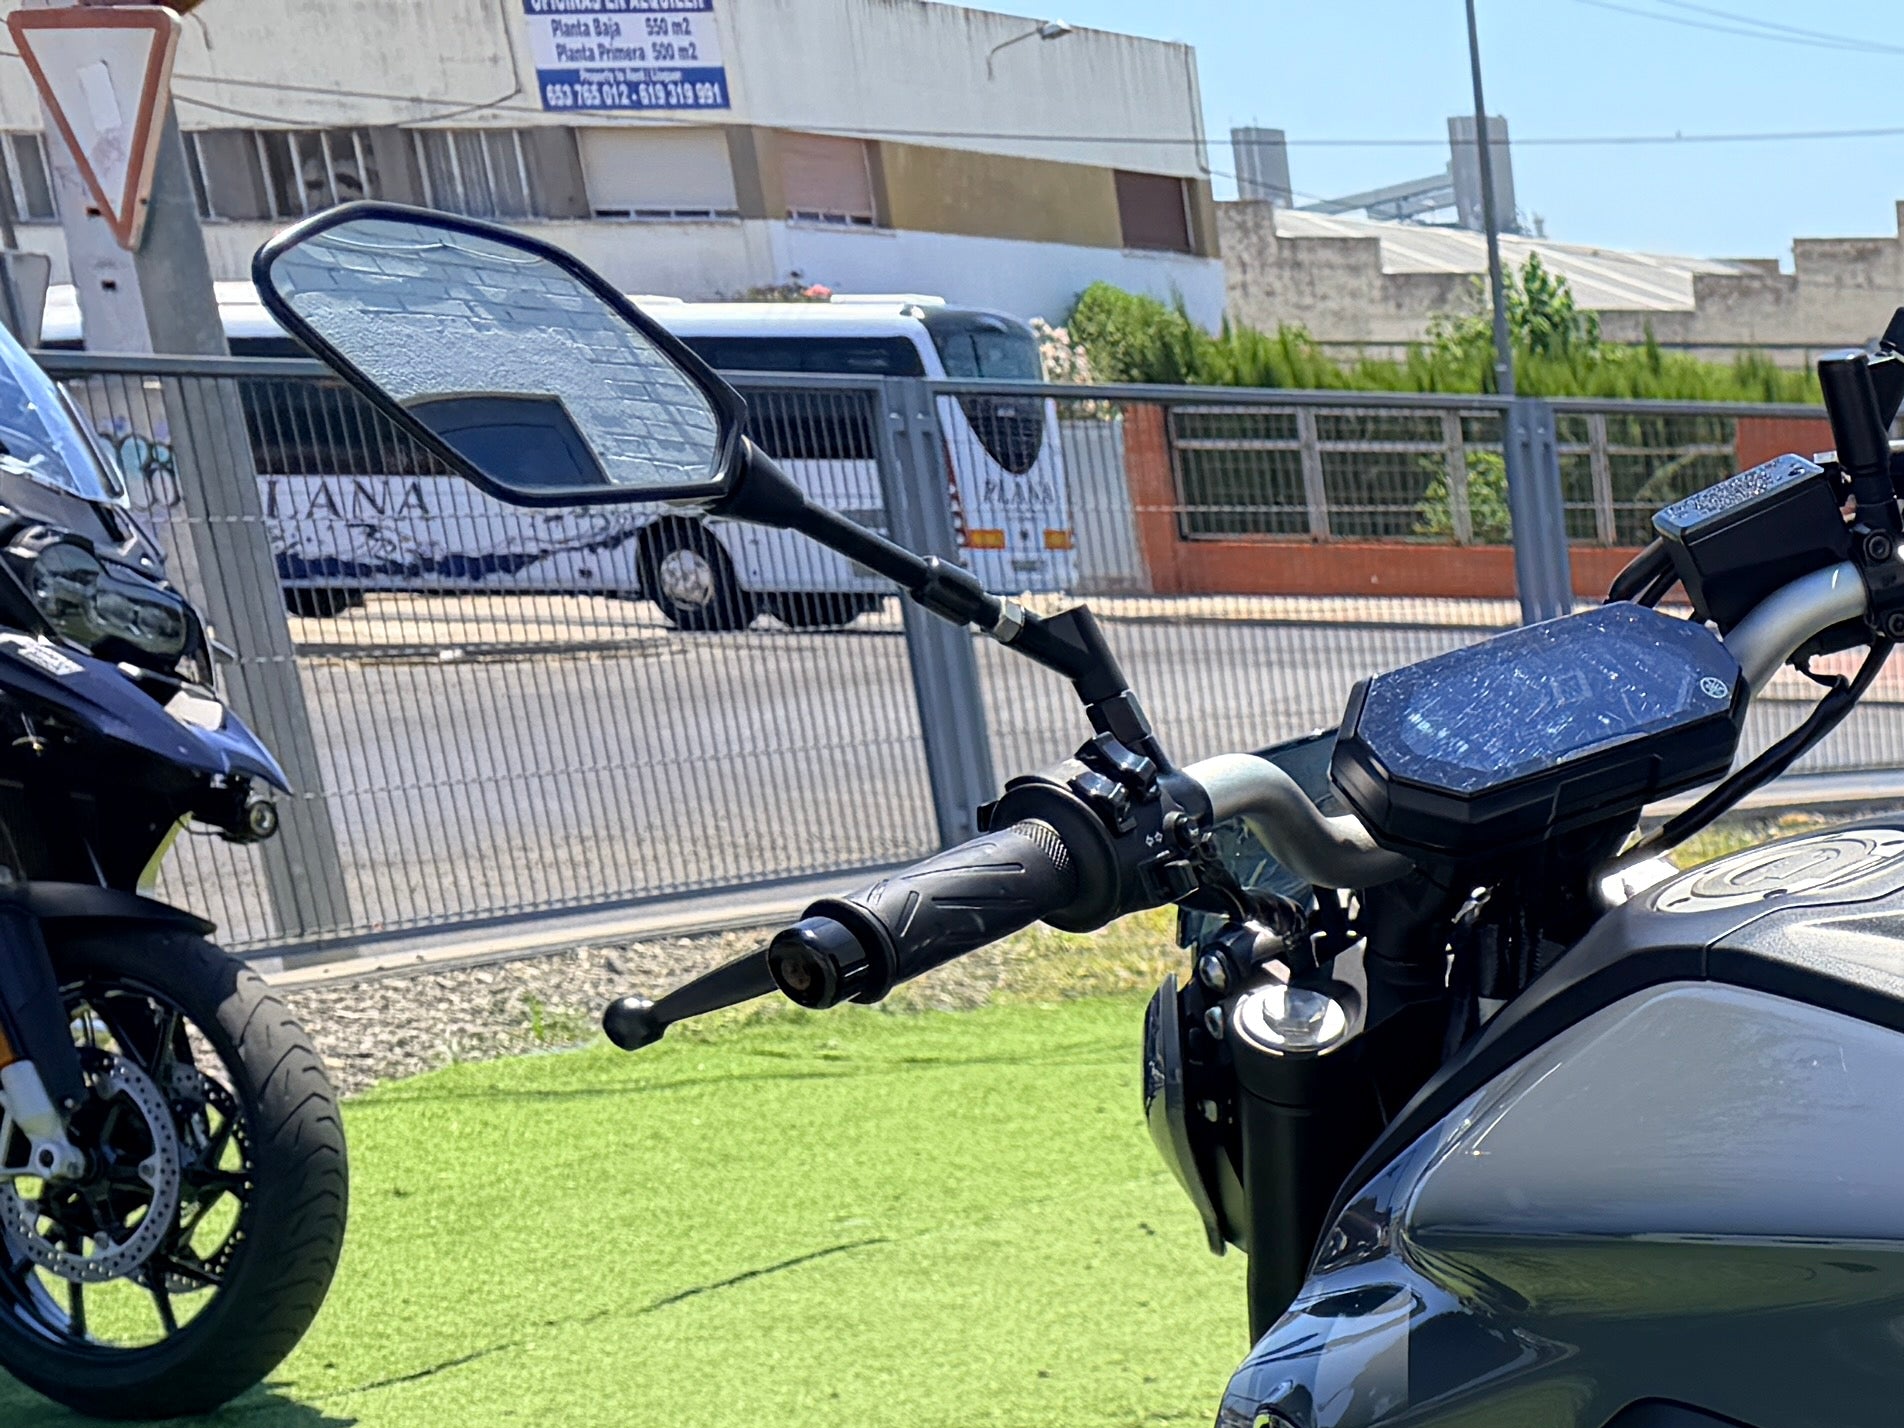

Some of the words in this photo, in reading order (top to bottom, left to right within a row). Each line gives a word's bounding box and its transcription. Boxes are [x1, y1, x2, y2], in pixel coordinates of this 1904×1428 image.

[551, 18, 591, 38] Planta
[593, 17, 621, 46] Baja
[671, 17, 692, 36] m2
[556, 43, 596, 62] Planta
[598, 43, 645, 61] Primera
[678, 42, 698, 60] m2
